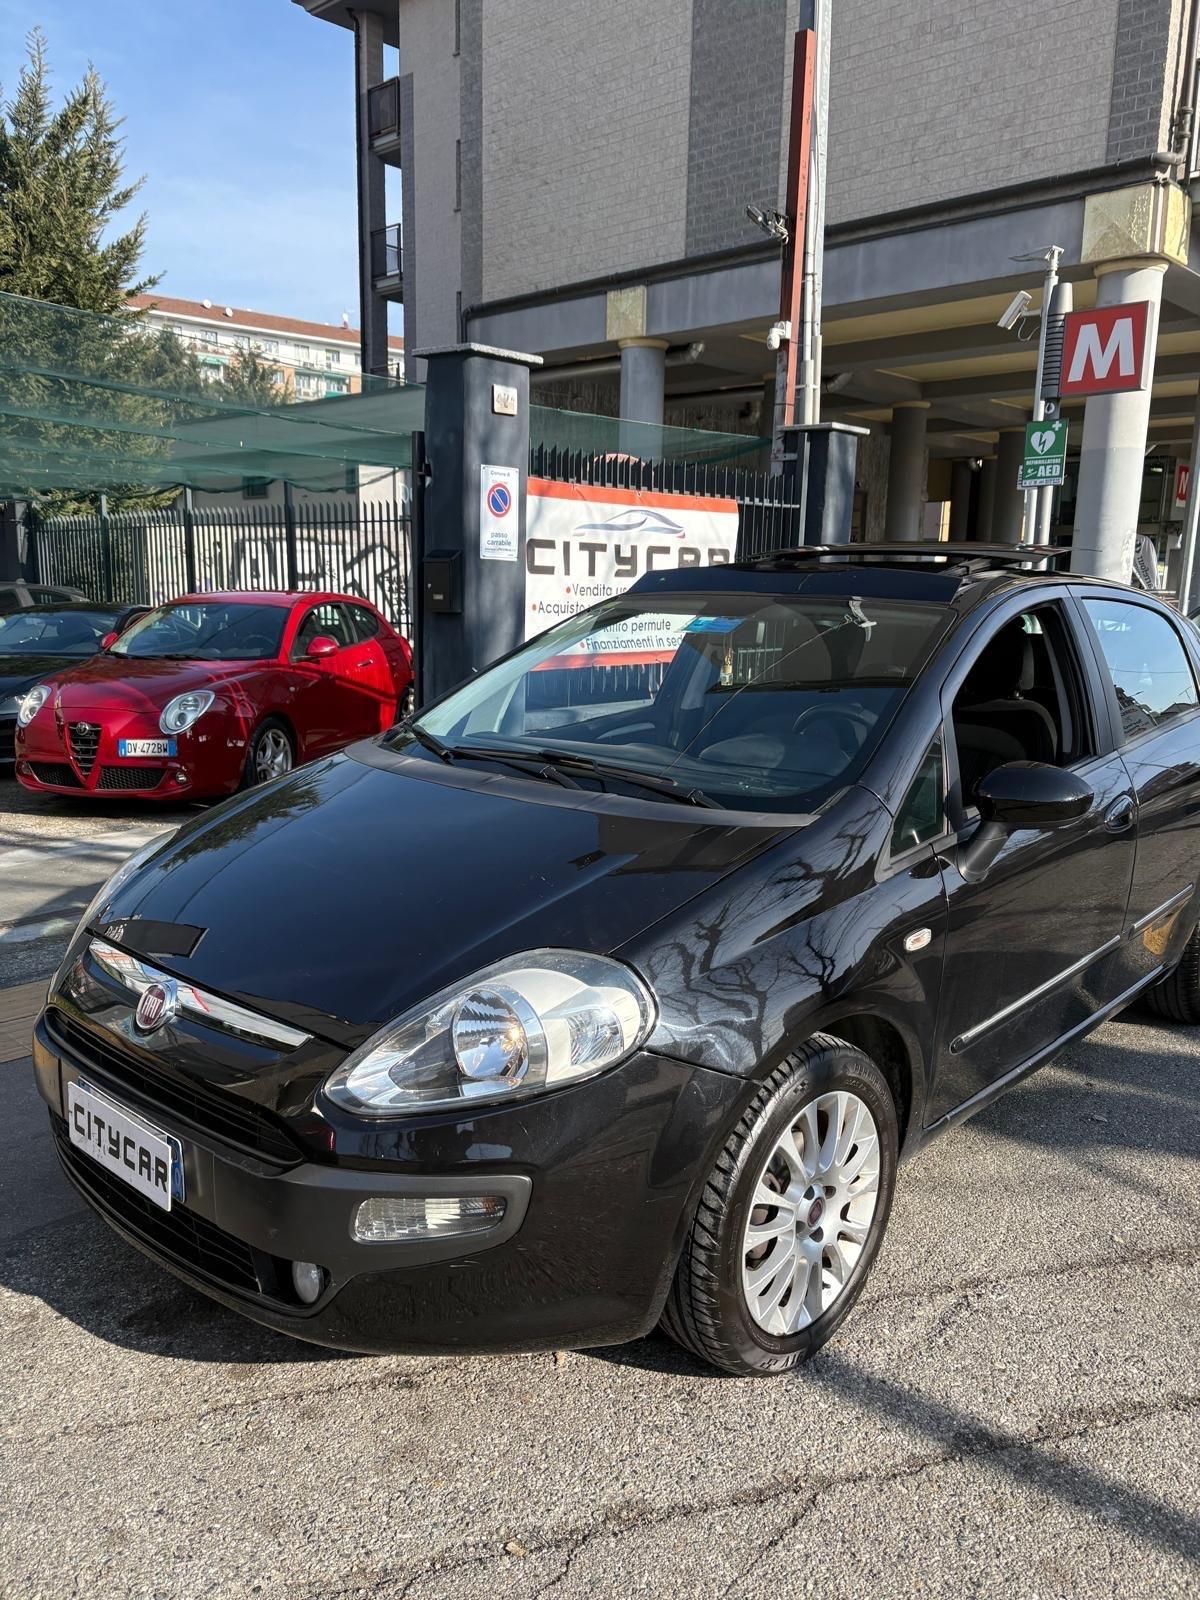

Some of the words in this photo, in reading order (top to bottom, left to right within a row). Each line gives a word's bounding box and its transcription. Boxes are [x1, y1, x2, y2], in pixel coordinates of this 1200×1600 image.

[1067, 317, 1135, 382] M
[1037, 464, 1061, 477] AED
[572, 583, 612, 597] Vendita
[538, 601, 585, 616] Acquisto
[631, 619, 671, 633] permute
[586, 636, 653, 651] Finanziamenti
[655, 635, 664, 648] in
[667, 635, 684, 647] sed
[141, 994, 163, 1019] FIAT
[73, 1102, 168, 1193] CITYCAR
